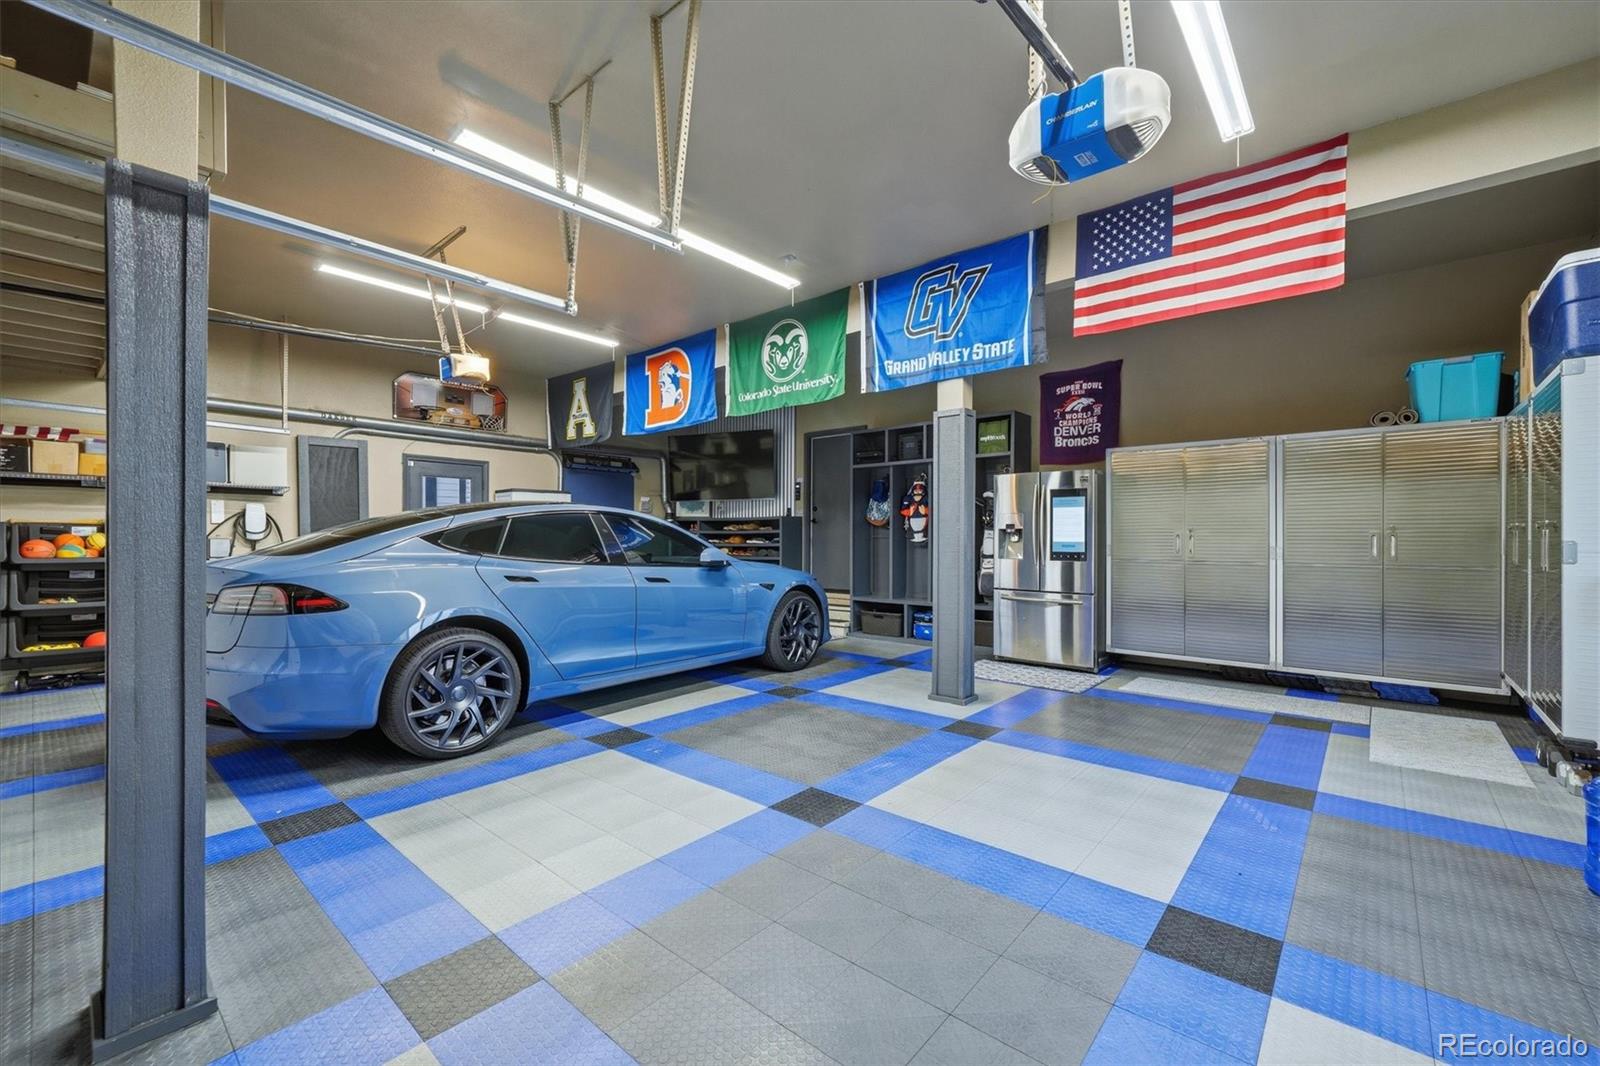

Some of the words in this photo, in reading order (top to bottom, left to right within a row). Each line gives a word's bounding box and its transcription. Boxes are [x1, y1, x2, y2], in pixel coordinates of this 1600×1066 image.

[1046, 99, 1098, 126] CHAMBERLAIN
[884, 356, 927, 376] GRAND
[927, 347, 971, 368] VALLEY
[972, 338, 1016, 361] STATE
[738, 388, 772, 402] Colorado
[772, 383, 793, 397] State
[1056, 384, 1080, 395] SUPER
[1082, 382, 1103, 390] BOWL
[1054, 423, 1102, 437] DENVER
